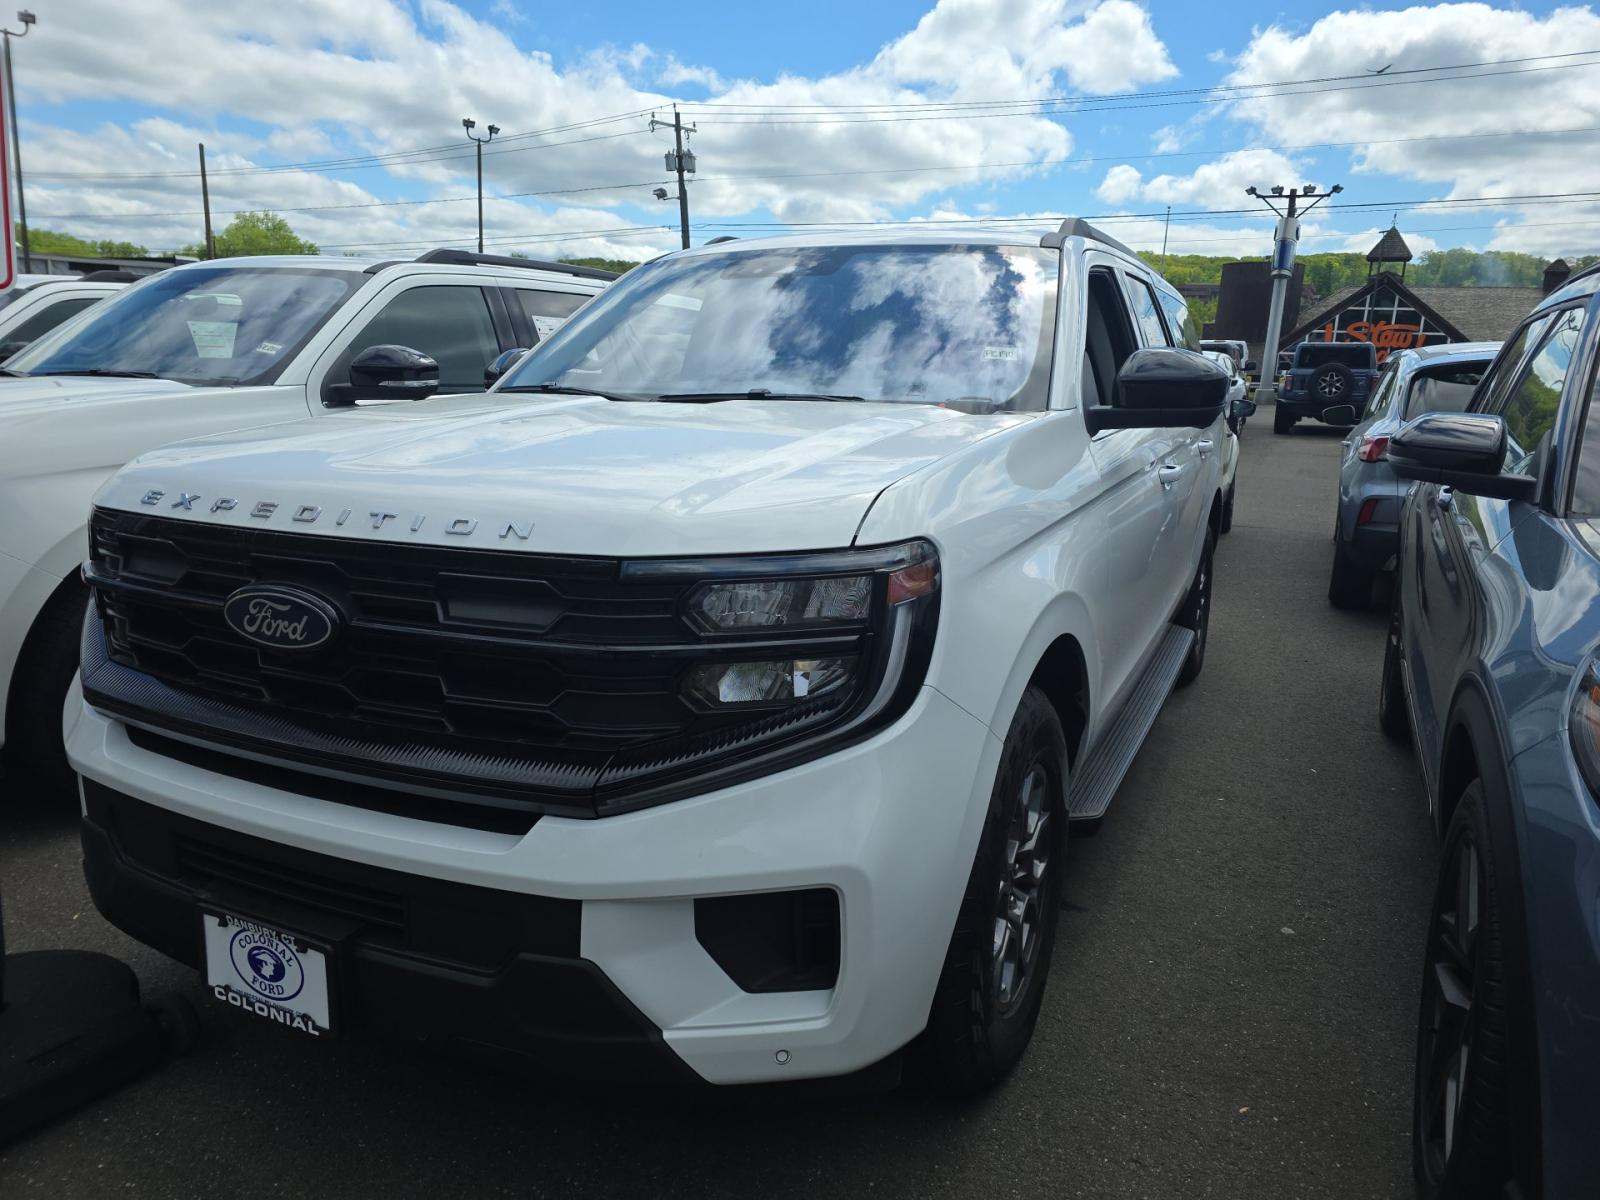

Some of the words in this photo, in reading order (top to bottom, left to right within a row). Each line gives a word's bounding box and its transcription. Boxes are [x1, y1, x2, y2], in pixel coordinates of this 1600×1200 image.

[141, 489, 536, 540] EXPEDITION
[243, 598, 308, 641] Ford
[238, 933, 294, 967] COLONIAL
[251, 975, 285, 996] FORD
[214, 985, 321, 1036] COLONIAL
